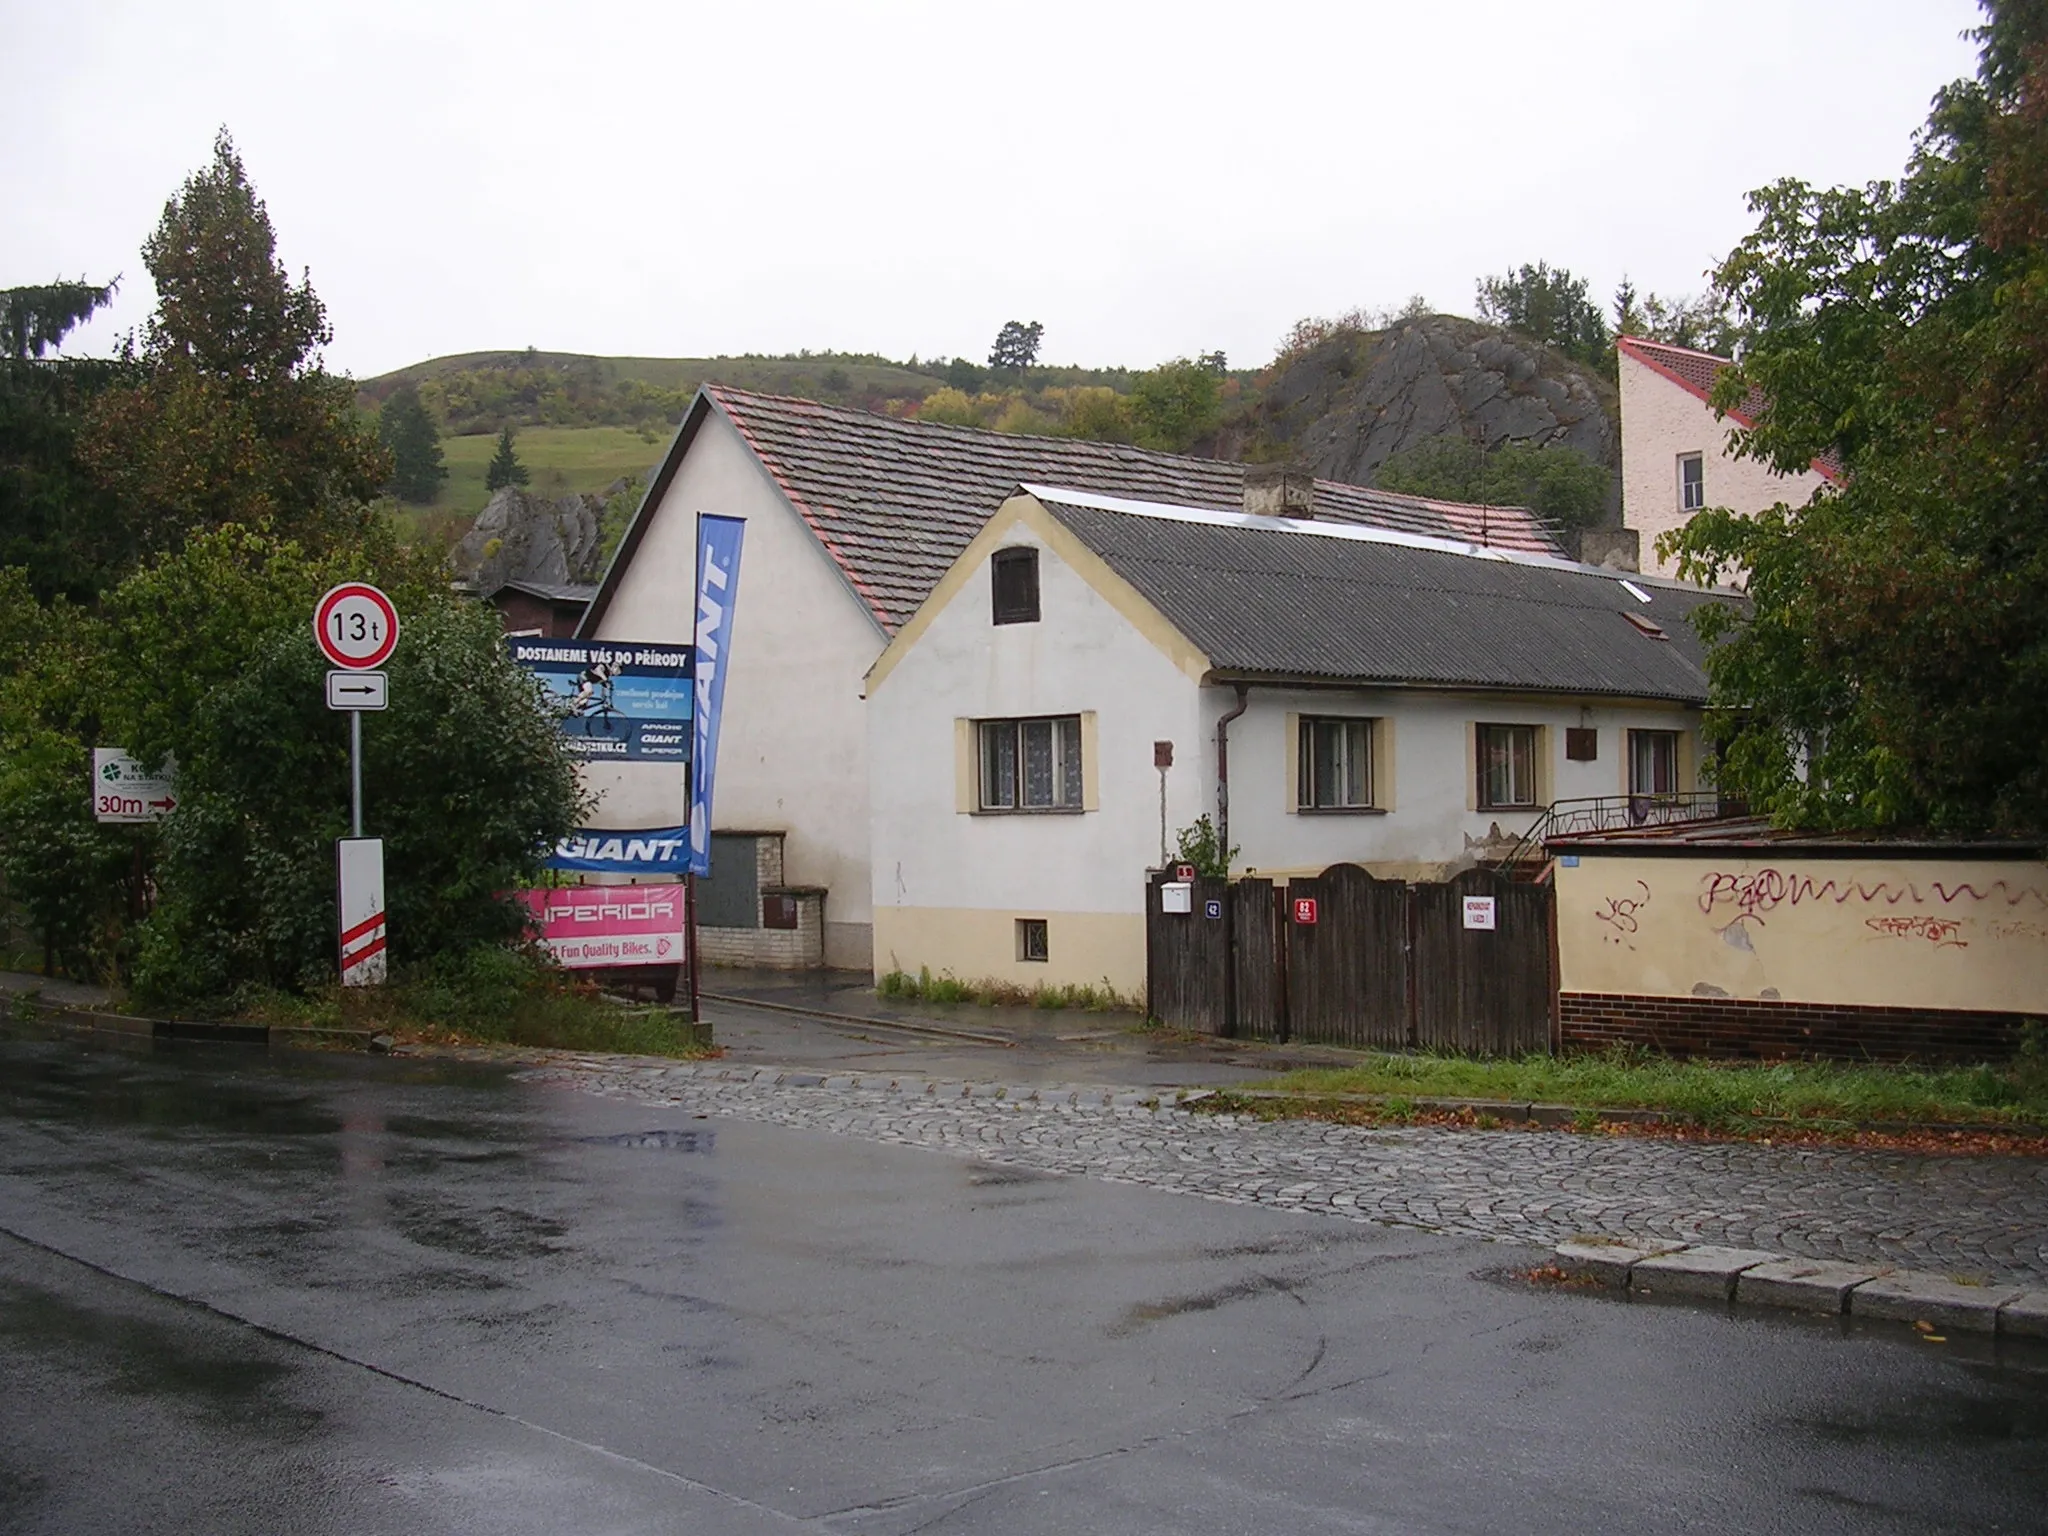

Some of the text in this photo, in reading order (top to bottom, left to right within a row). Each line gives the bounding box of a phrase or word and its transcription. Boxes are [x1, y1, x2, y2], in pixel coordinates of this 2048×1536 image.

[334, 613, 379, 641] 13 t
[517, 646, 686, 667] DOSTANEME VÁS DO PŘÍRODY
[641, 734, 683, 744] GIANT
[98, 796, 142, 813] 30m
[556, 836, 683, 861] GIANT
[561, 945, 580, 958] Fun
[582, 943, 619, 959] Quality
[622, 941, 652, 955] Bikes.
